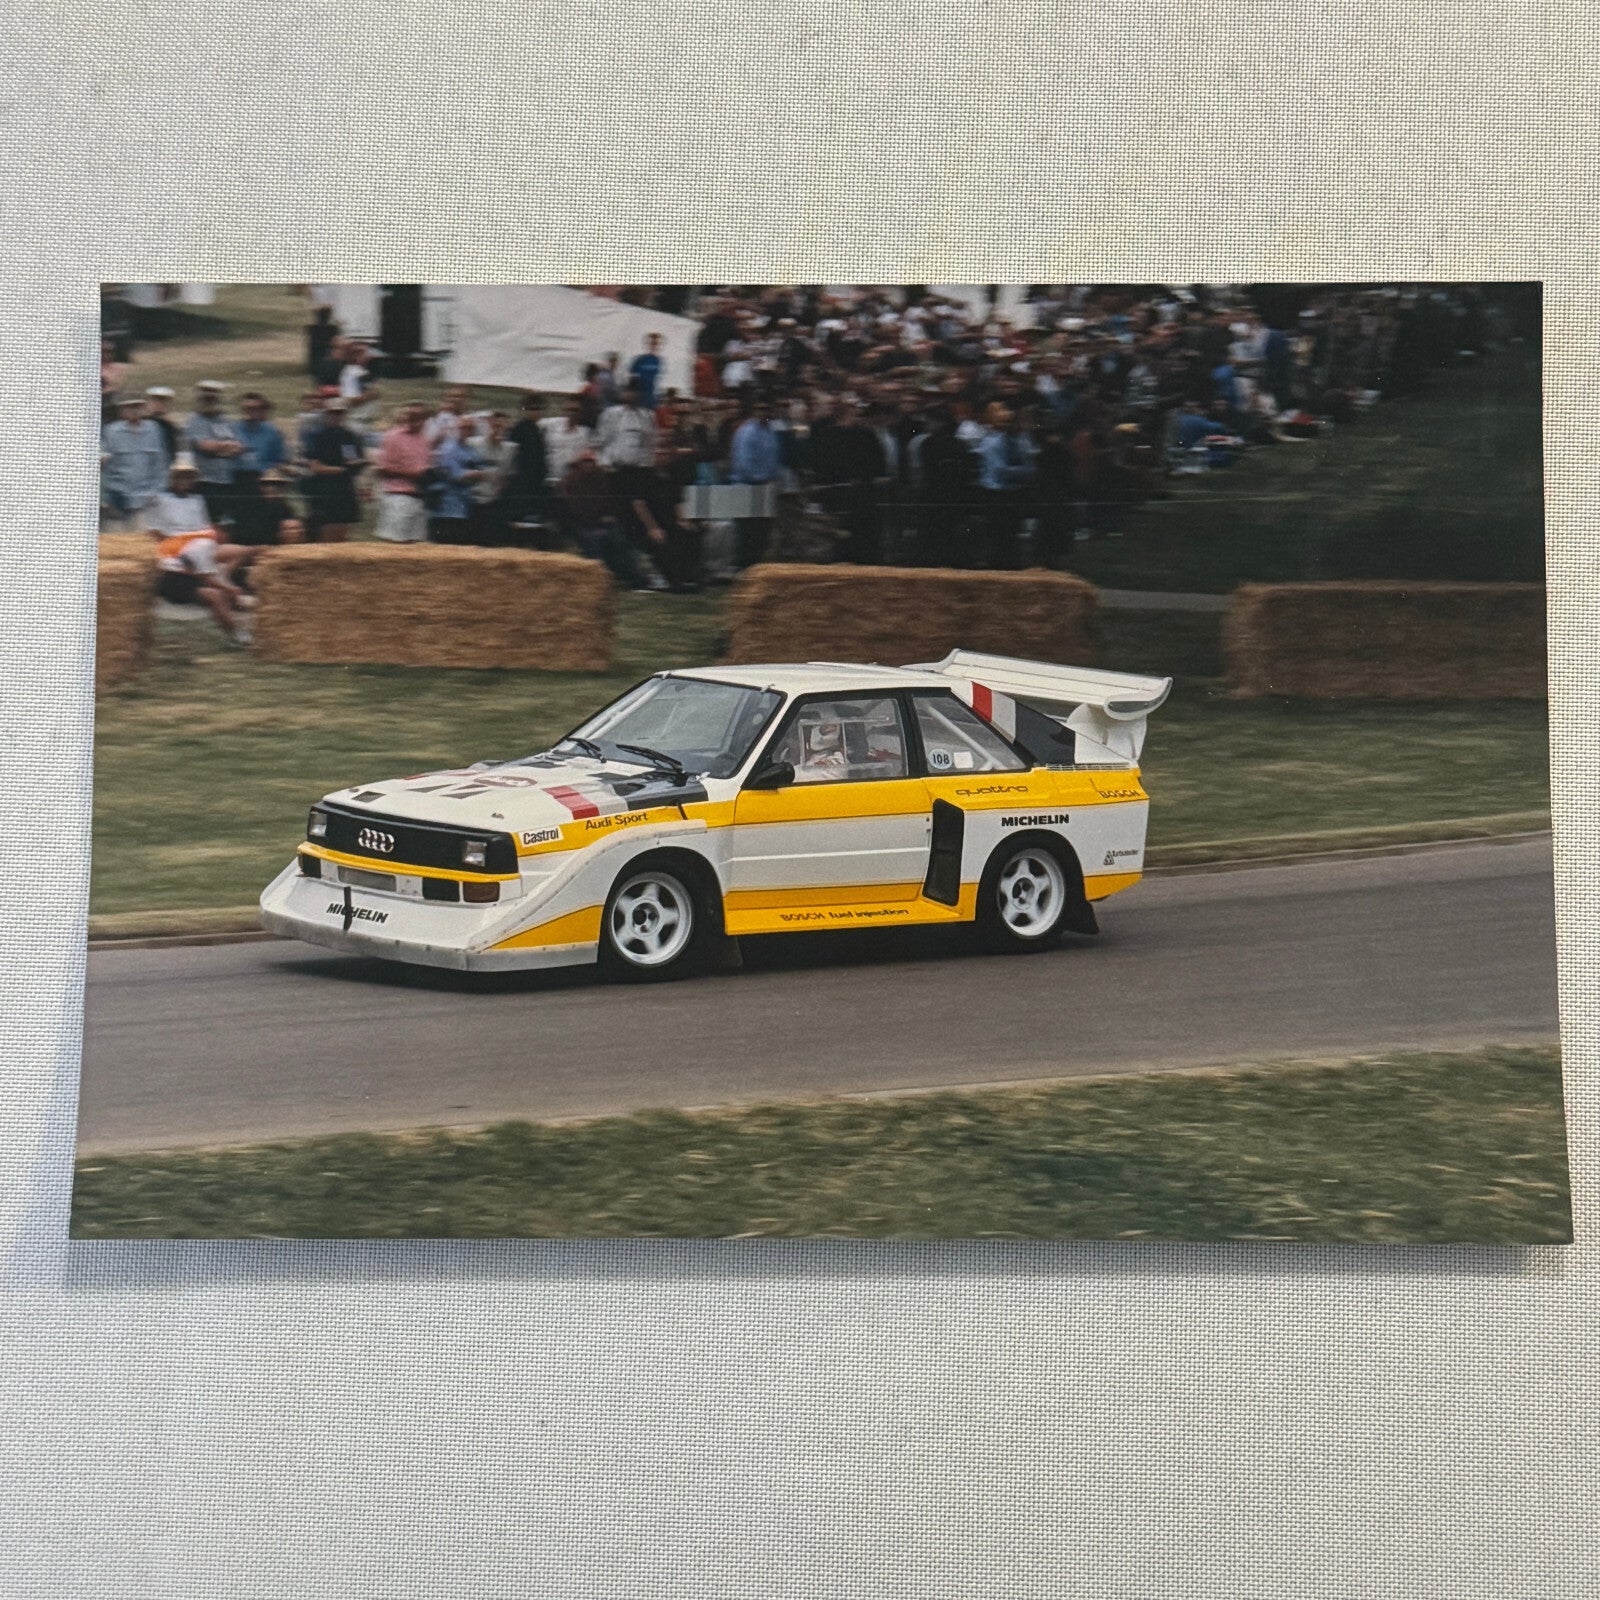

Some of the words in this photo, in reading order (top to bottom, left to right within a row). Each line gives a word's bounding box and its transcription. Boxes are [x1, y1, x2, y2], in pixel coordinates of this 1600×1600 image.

[932, 753, 950, 765] 108
[955, 785, 1029, 796] quattro
[1098, 789, 1141, 798] BOSCH
[585, 816, 612, 830] Audi
[614, 812, 648, 826] Sport
[1001, 814, 1070, 827] MICHELIN
[523, 828, 559, 845] Castrol
[780, 912, 826, 921] BOSCH
[828, 910, 854, 919] fuel
